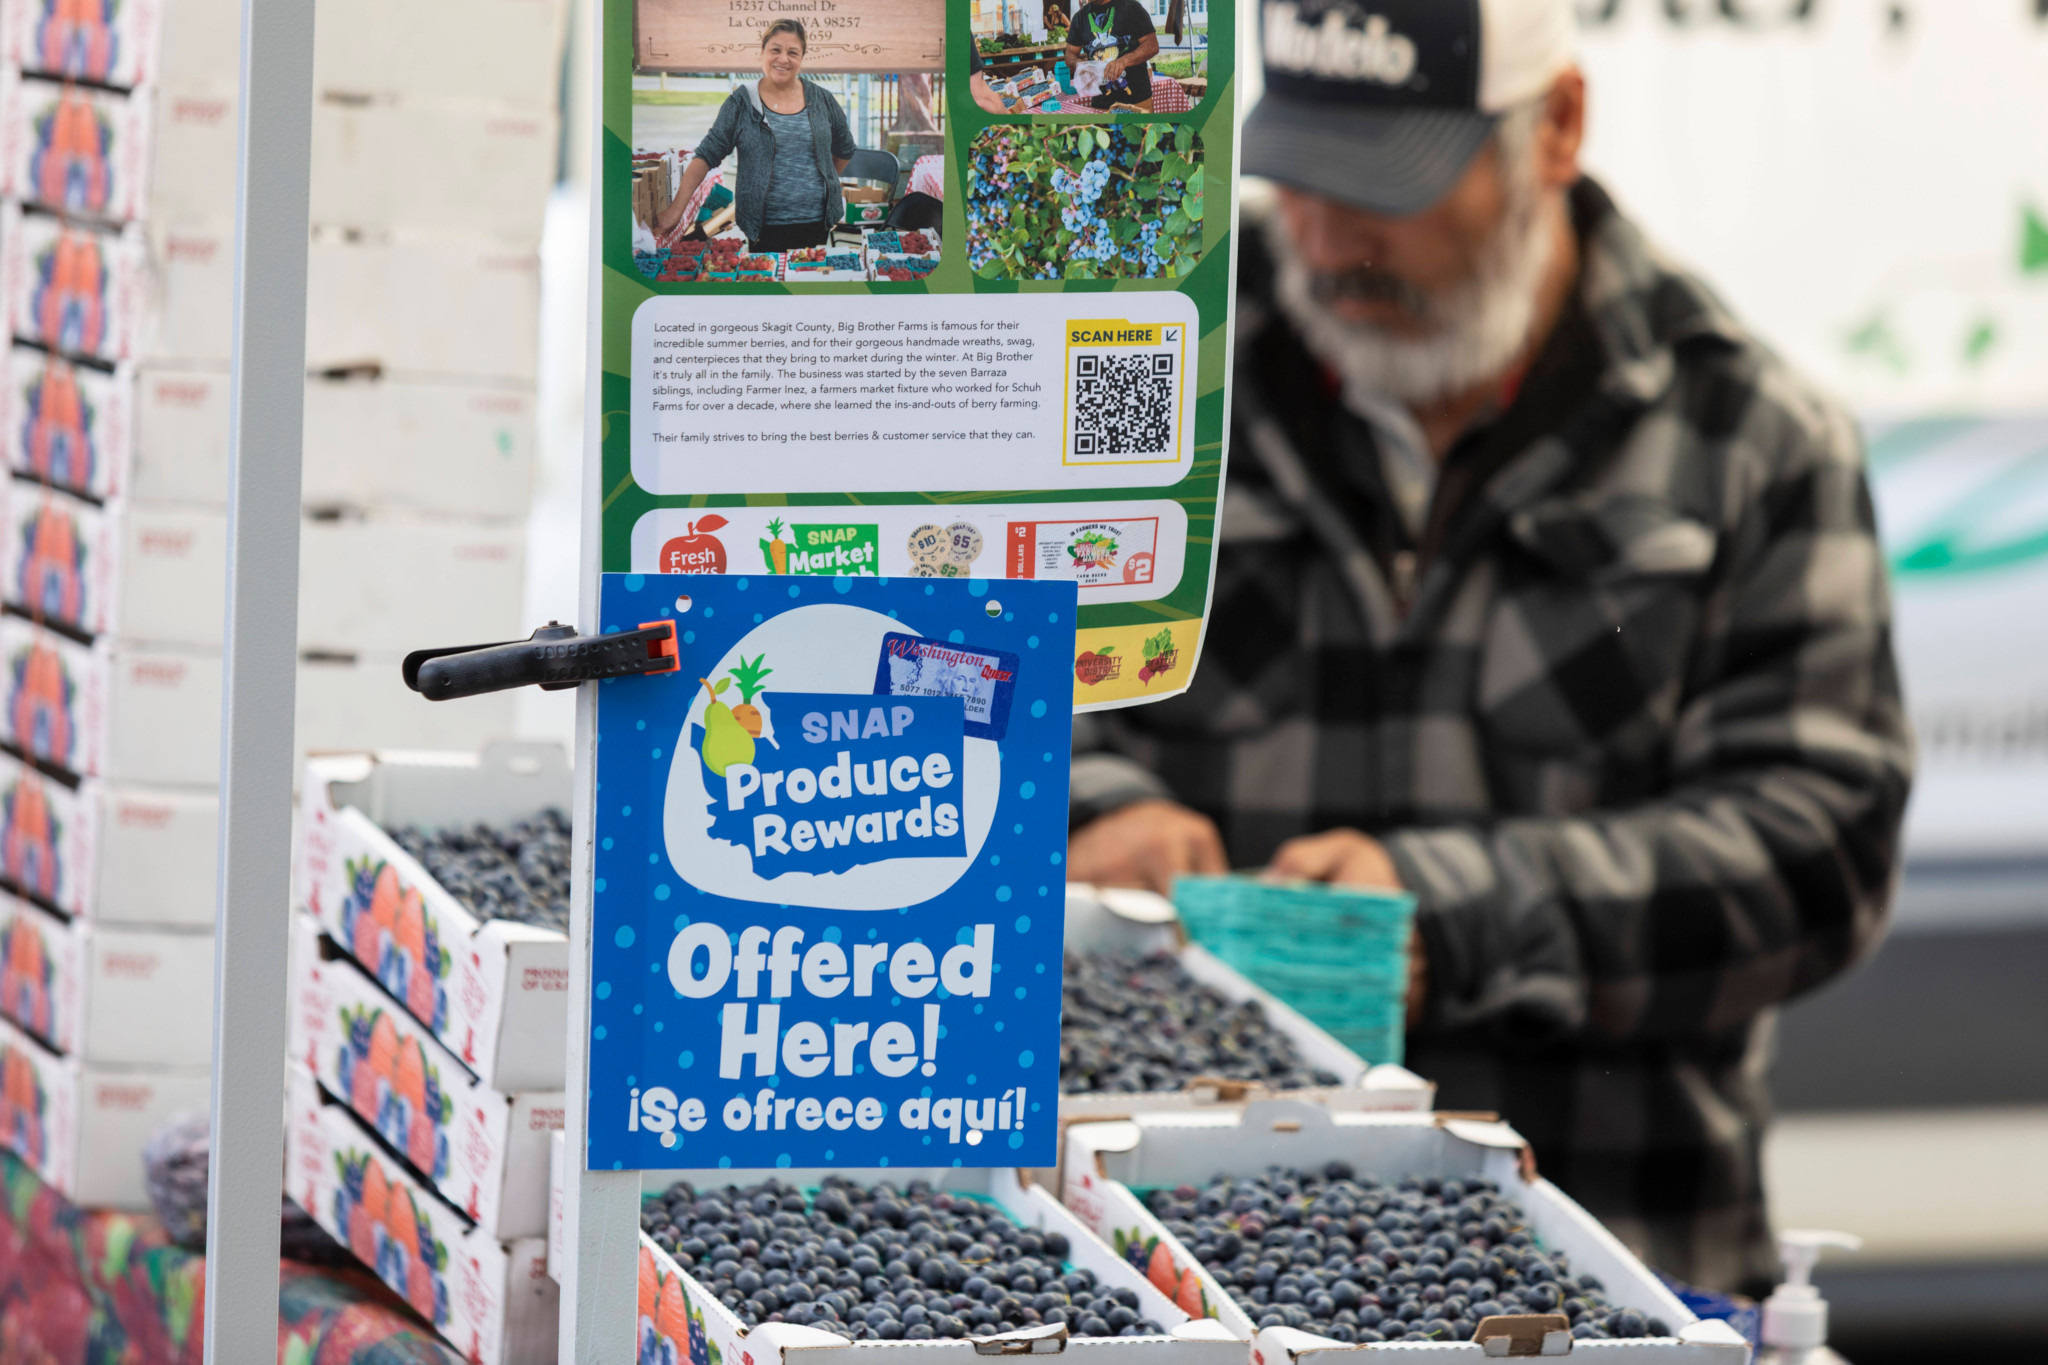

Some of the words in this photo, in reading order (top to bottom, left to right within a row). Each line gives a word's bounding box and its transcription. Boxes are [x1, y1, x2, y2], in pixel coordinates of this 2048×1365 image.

[729, 0, 764, 11] 15237
[768, 0, 817, 11] Channel
[821, 0, 836, 11] Dr
[729, 17, 742, 27] La
[824, 17, 861, 27] 98257
[654, 322, 695, 332] Located
[698, 322, 706, 331] in
[709, 324, 758, 334] gorgeous
[761, 321, 792, 333] Skagit
[795, 321, 834, 333] County,
[837, 321, 854, 332] Big
[857, 320, 895, 331] Brother
[898, 320, 928, 331] Farms
[930, 321, 938, 330] is
[940, 319, 977, 330] famous
[980, 319, 994, 330] for
[996, 319, 1020, 330] their
[653, 337, 704, 348] incredible
[750, 337, 787, 348] berries,
[790, 337, 810, 347] and
[812, 336, 827, 347] for
[829, 337, 852, 347] their
[855, 339, 903, 350] gorgeous
[906, 336, 960, 346] handmade
[962, 335, 1003, 347] wreaths,
[1006, 338, 1034, 349] swag,
[1072, 331, 1113, 342] SCAN
[1118, 330, 1152, 341] HERE
[652, 353, 673, 364] and
[675, 354, 740, 365] centerpieces
[742, 353, 763, 363] that
[764, 352, 788, 365] they
[790, 352, 817, 365] bring
[819, 354, 831, 363] to
[832, 352, 868, 362] market
[870, 352, 904, 364] during
[905, 351, 922, 362] the
[924, 352, 959, 362] winter.
[960, 352, 974, 361] At
[976, 351, 993, 364] Big
[995, 350, 1034, 361] Brother
[652, 370, 668, 379] it's
[670, 369, 692, 381] truly
[694, 368, 707, 379] all
[709, 369, 718, 379] in
[720, 368, 738, 379] the
[740, 368, 774, 381] family.
[776, 368, 796, 378] The
[798, 368, 842, 378] business
[866, 367, 902, 378] started
[904, 367, 917, 380] by
[918, 367, 936, 377] the
[970, 366, 1007, 377] Barraza
[652, 384, 692, 397] siblings,
[696, 384, 742, 396] including
[746, 384, 781, 394] Farmer
[784, 384, 807, 395] Inez,
[819, 383, 857, 394] farmers
[860, 383, 894, 394] market
[897, 382, 928, 393] fixture
[931, 382, 952, 393] who
[955, 382, 992, 392] worked
[994, 381, 1009, 392] for
[1012, 381, 1041, 392] Schuh
[652, 400, 682, 411] Farms
[685, 400, 699, 410] for
[736, 399, 776, 411] decade,
[780, 399, 811, 410] where
[814, 399, 831, 409] she
[834, 399, 872, 409] learned
[875, 398, 891, 409] the
[894, 398, 955, 409] ins-and-outs
[958, 397, 968, 408] of
[971, 397, 997, 411] berry
[1000, 397, 1041, 410] farming.
[652, 432, 678, 442] Their
[680, 431, 710, 444] family
[712, 432, 744, 442] strives
[746, 432, 758, 441] to
[760, 430, 787, 443] bring
[790, 430, 807, 441] the
[809, 430, 831, 441] best
[834, 430, 869, 440] berries
[871, 430, 879, 440] &
[882, 431, 929, 440] customer
[931, 430, 966, 440] service
[968, 429, 988, 439] that
[990, 428, 1012, 441] they
[807, 527, 858, 546] SNAP
[1076, 524, 1098, 534] FARMERS
[1108, 526, 1122, 536] TRUST
[918, 534, 936, 550] $10
[952, 534, 971, 548] $5
[670, 548, 716, 566] Fresh
[790, 542, 874, 574] Market
[940, 563, 958, 577] $2
[1128, 558, 1151, 581] $2
[887, 638, 984, 668] Washington
[1084, 665, 1122, 676] DISTRICT
[900, 684, 920, 694] 5077
[923, 688, 942, 697] 1012
[966, 696, 986, 706] 7890
[803, 707, 913, 743] SNAP
[725, 751, 954, 812] Produce
[753, 795, 959, 857] Rewards
[668, 923, 994, 998] Offered
[720, 1003, 940, 1079] Here!
[629, 1086, 707, 1131] ¡Se
[723, 1089, 883, 1131] ofrece
[899, 1086, 1027, 1145] aquí!
